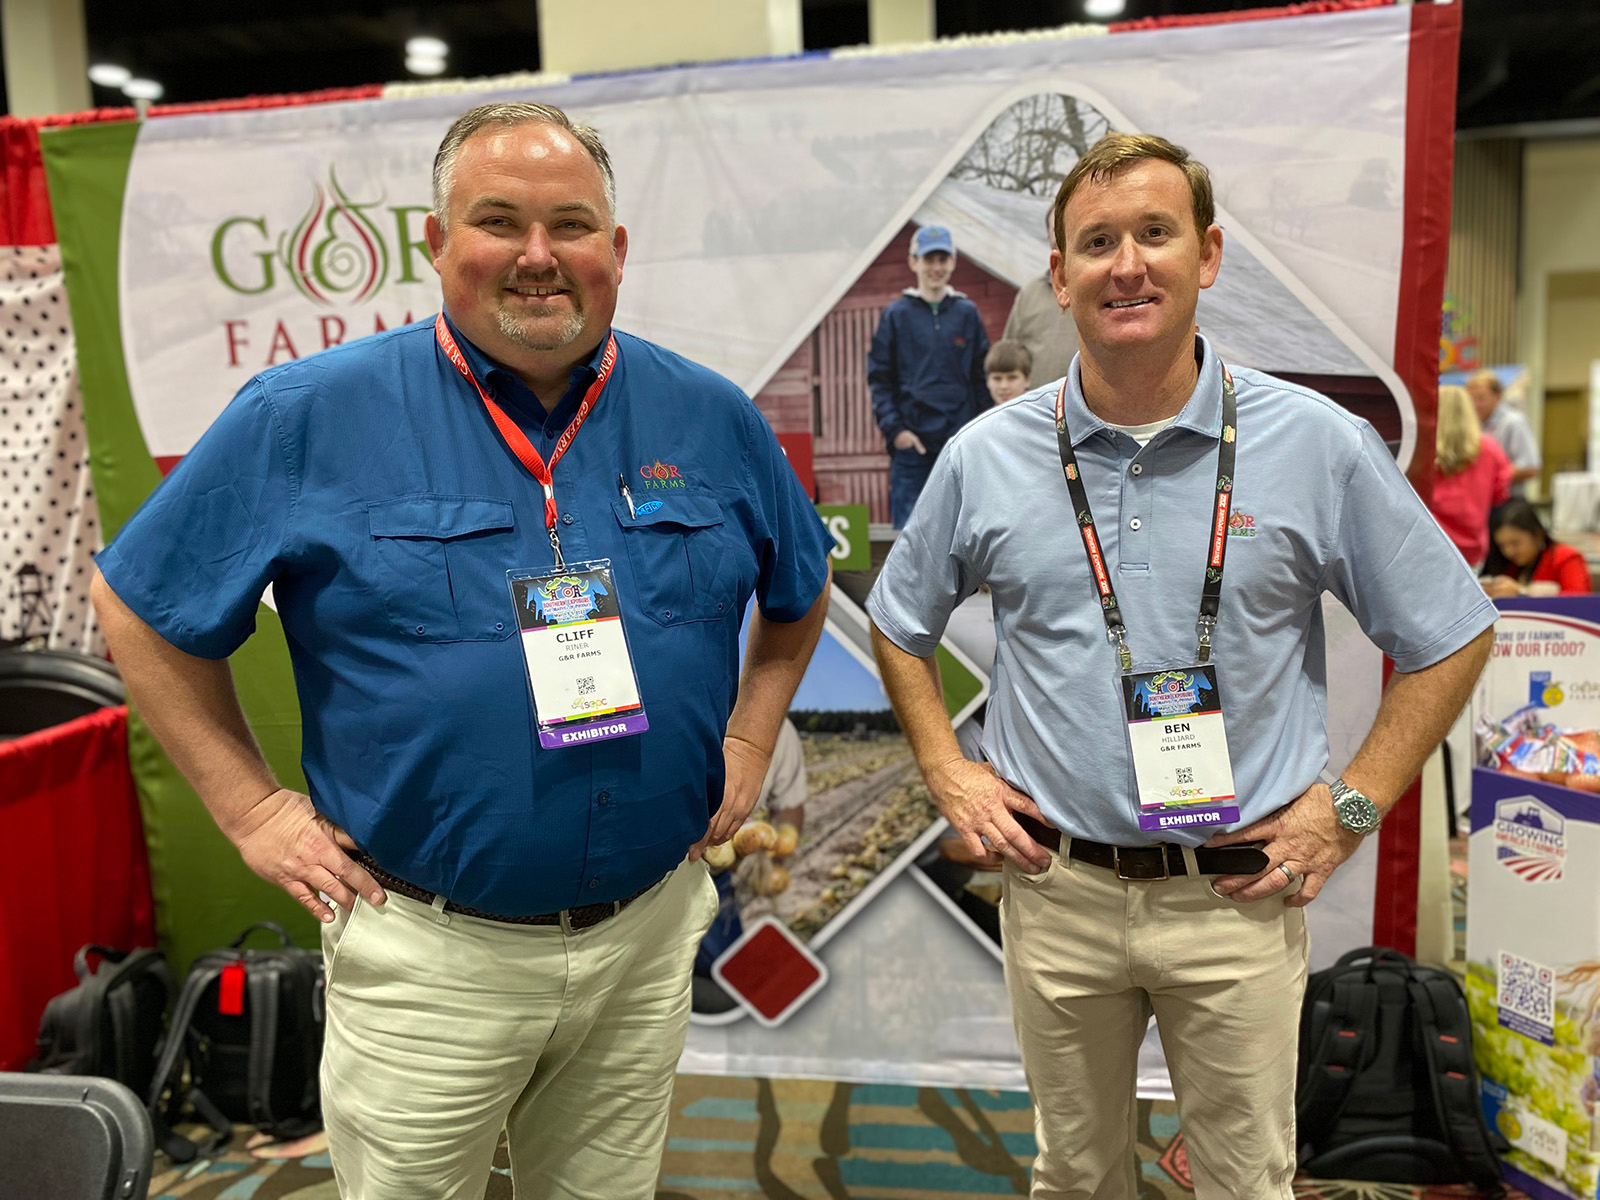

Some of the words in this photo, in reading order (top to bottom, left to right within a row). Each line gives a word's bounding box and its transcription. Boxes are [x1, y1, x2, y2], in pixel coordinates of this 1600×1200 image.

[644, 480, 686, 489] FARMS
[821, 515, 851, 560] S
[556, 629, 594, 643] CLIFF
[1516, 631, 1526, 640] OF
[1528, 631, 1565, 640] FARMING
[565, 642, 589, 652] RINER
[1515, 642, 1541, 657] OUR
[1544, 641, 1585, 656] FOOD?
[558, 654, 575, 662] G&R
[576, 650, 602, 659] FARMS
[561, 723, 627, 743] EXHIBITOR
[1164, 722, 1191, 734] BEN
[1161, 734, 1195, 743] HILLIARD
[1177, 742, 1201, 750] FARMS
[1159, 812, 1220, 826] EXHIBITOR
[1496, 821, 1564, 847] GROWING
